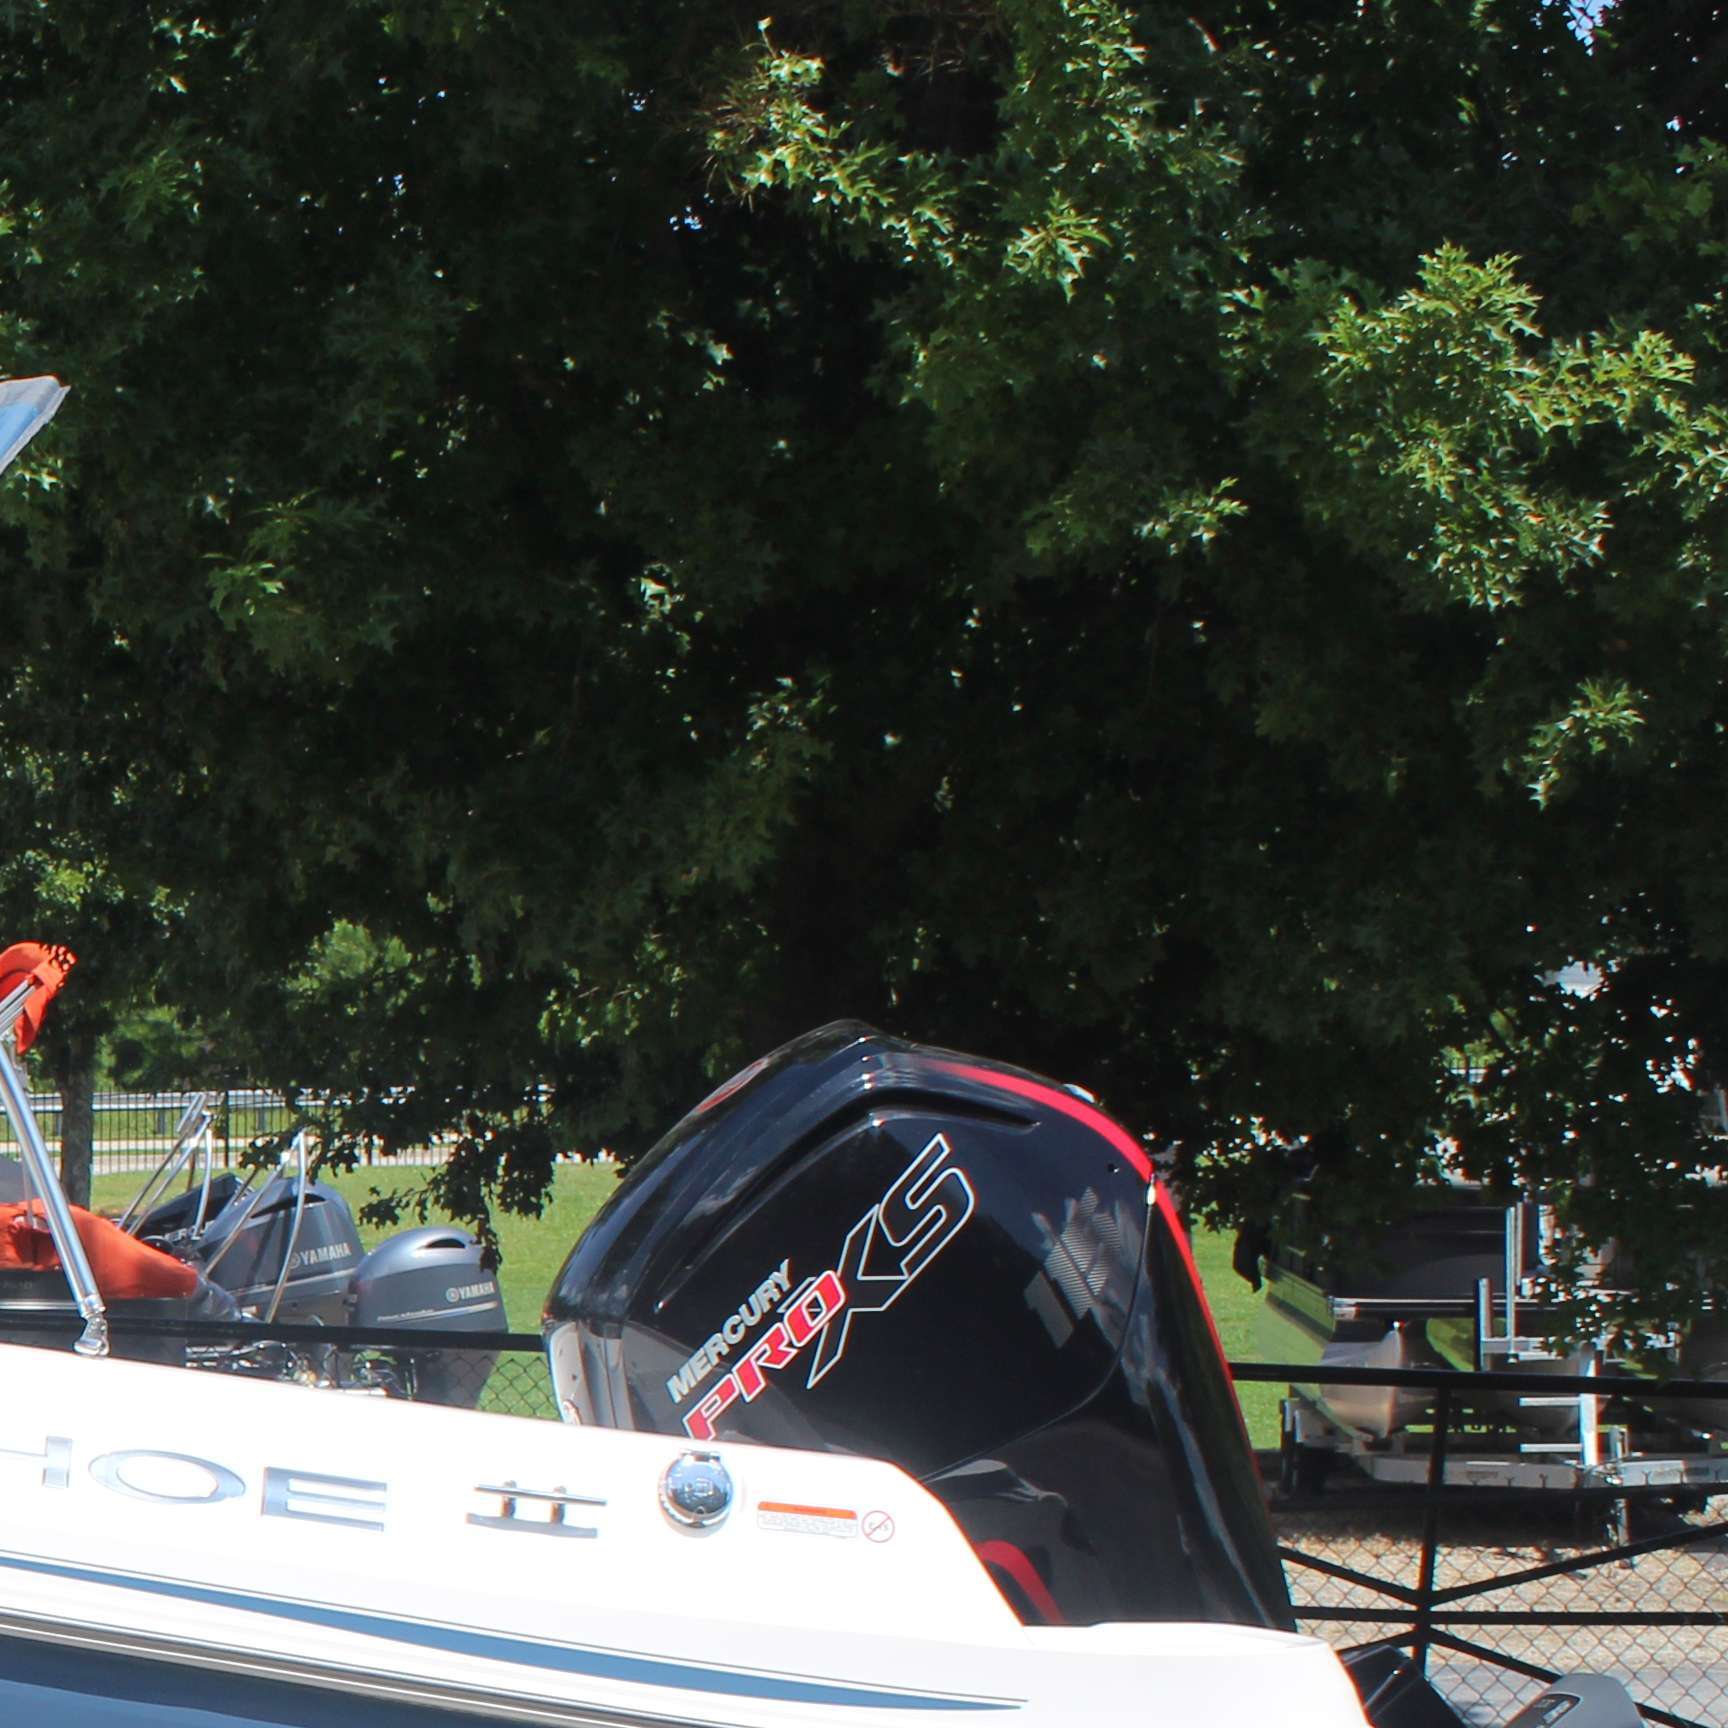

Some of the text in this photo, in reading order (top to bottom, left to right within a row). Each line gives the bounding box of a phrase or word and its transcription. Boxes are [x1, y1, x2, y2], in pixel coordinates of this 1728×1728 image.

[301, 1243, 352, 1265] YAMAHA
[458, 1281, 496, 1300] YAMAHA
[665, 1258, 797, 1403] MERCURY
[681, 1270, 846, 1441] PRO
